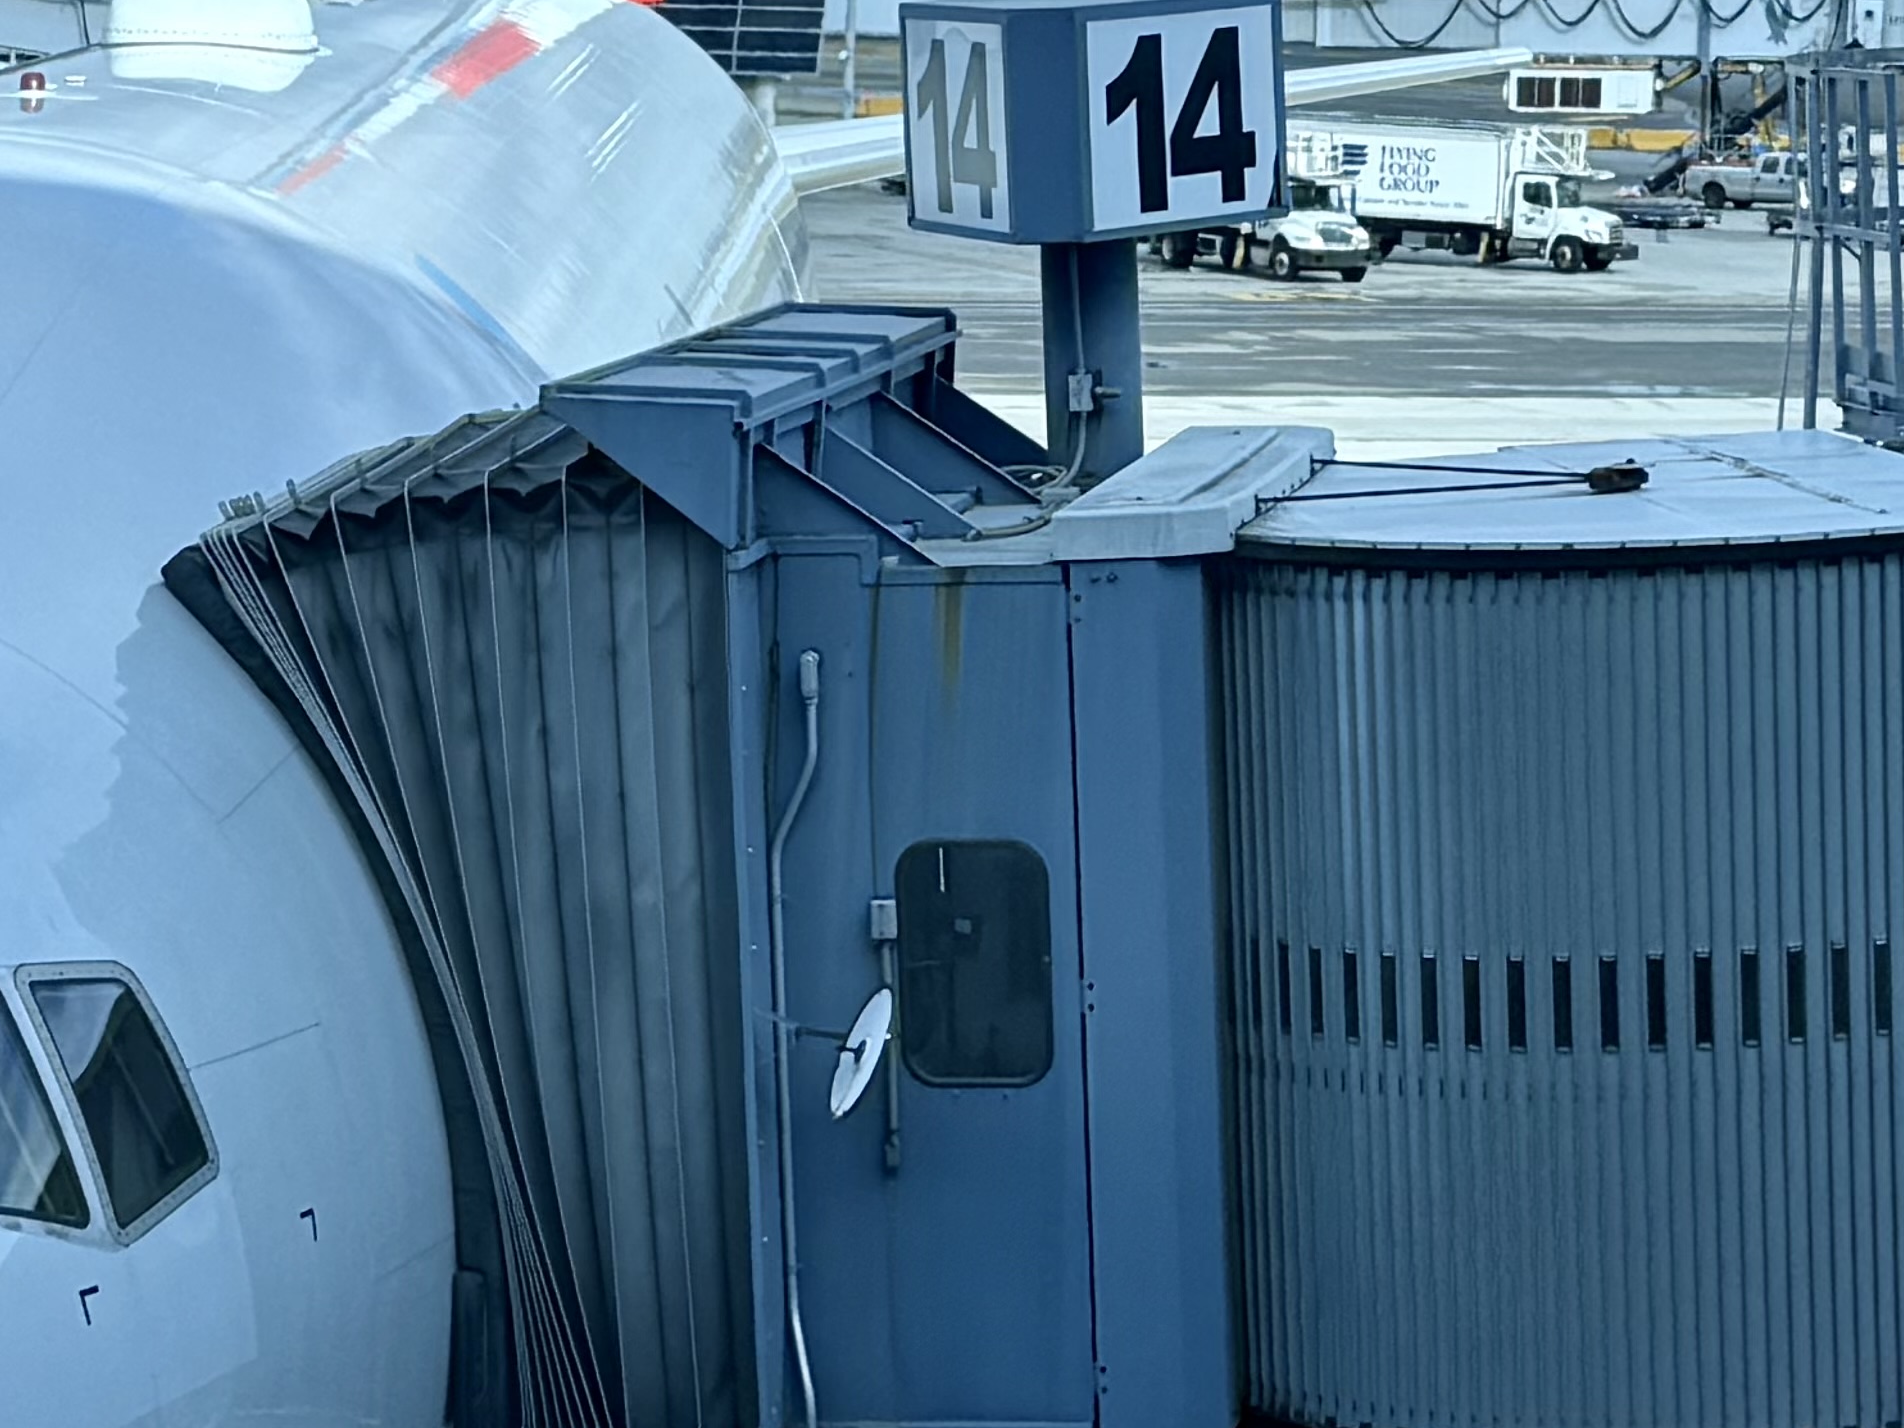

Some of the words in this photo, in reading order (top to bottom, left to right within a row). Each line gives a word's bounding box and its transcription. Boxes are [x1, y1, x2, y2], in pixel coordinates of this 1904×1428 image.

[917, 38, 997, 220] 14
[1105, 25, 1256, 214] 14
[1379, 176, 1440, 194] GROUP
